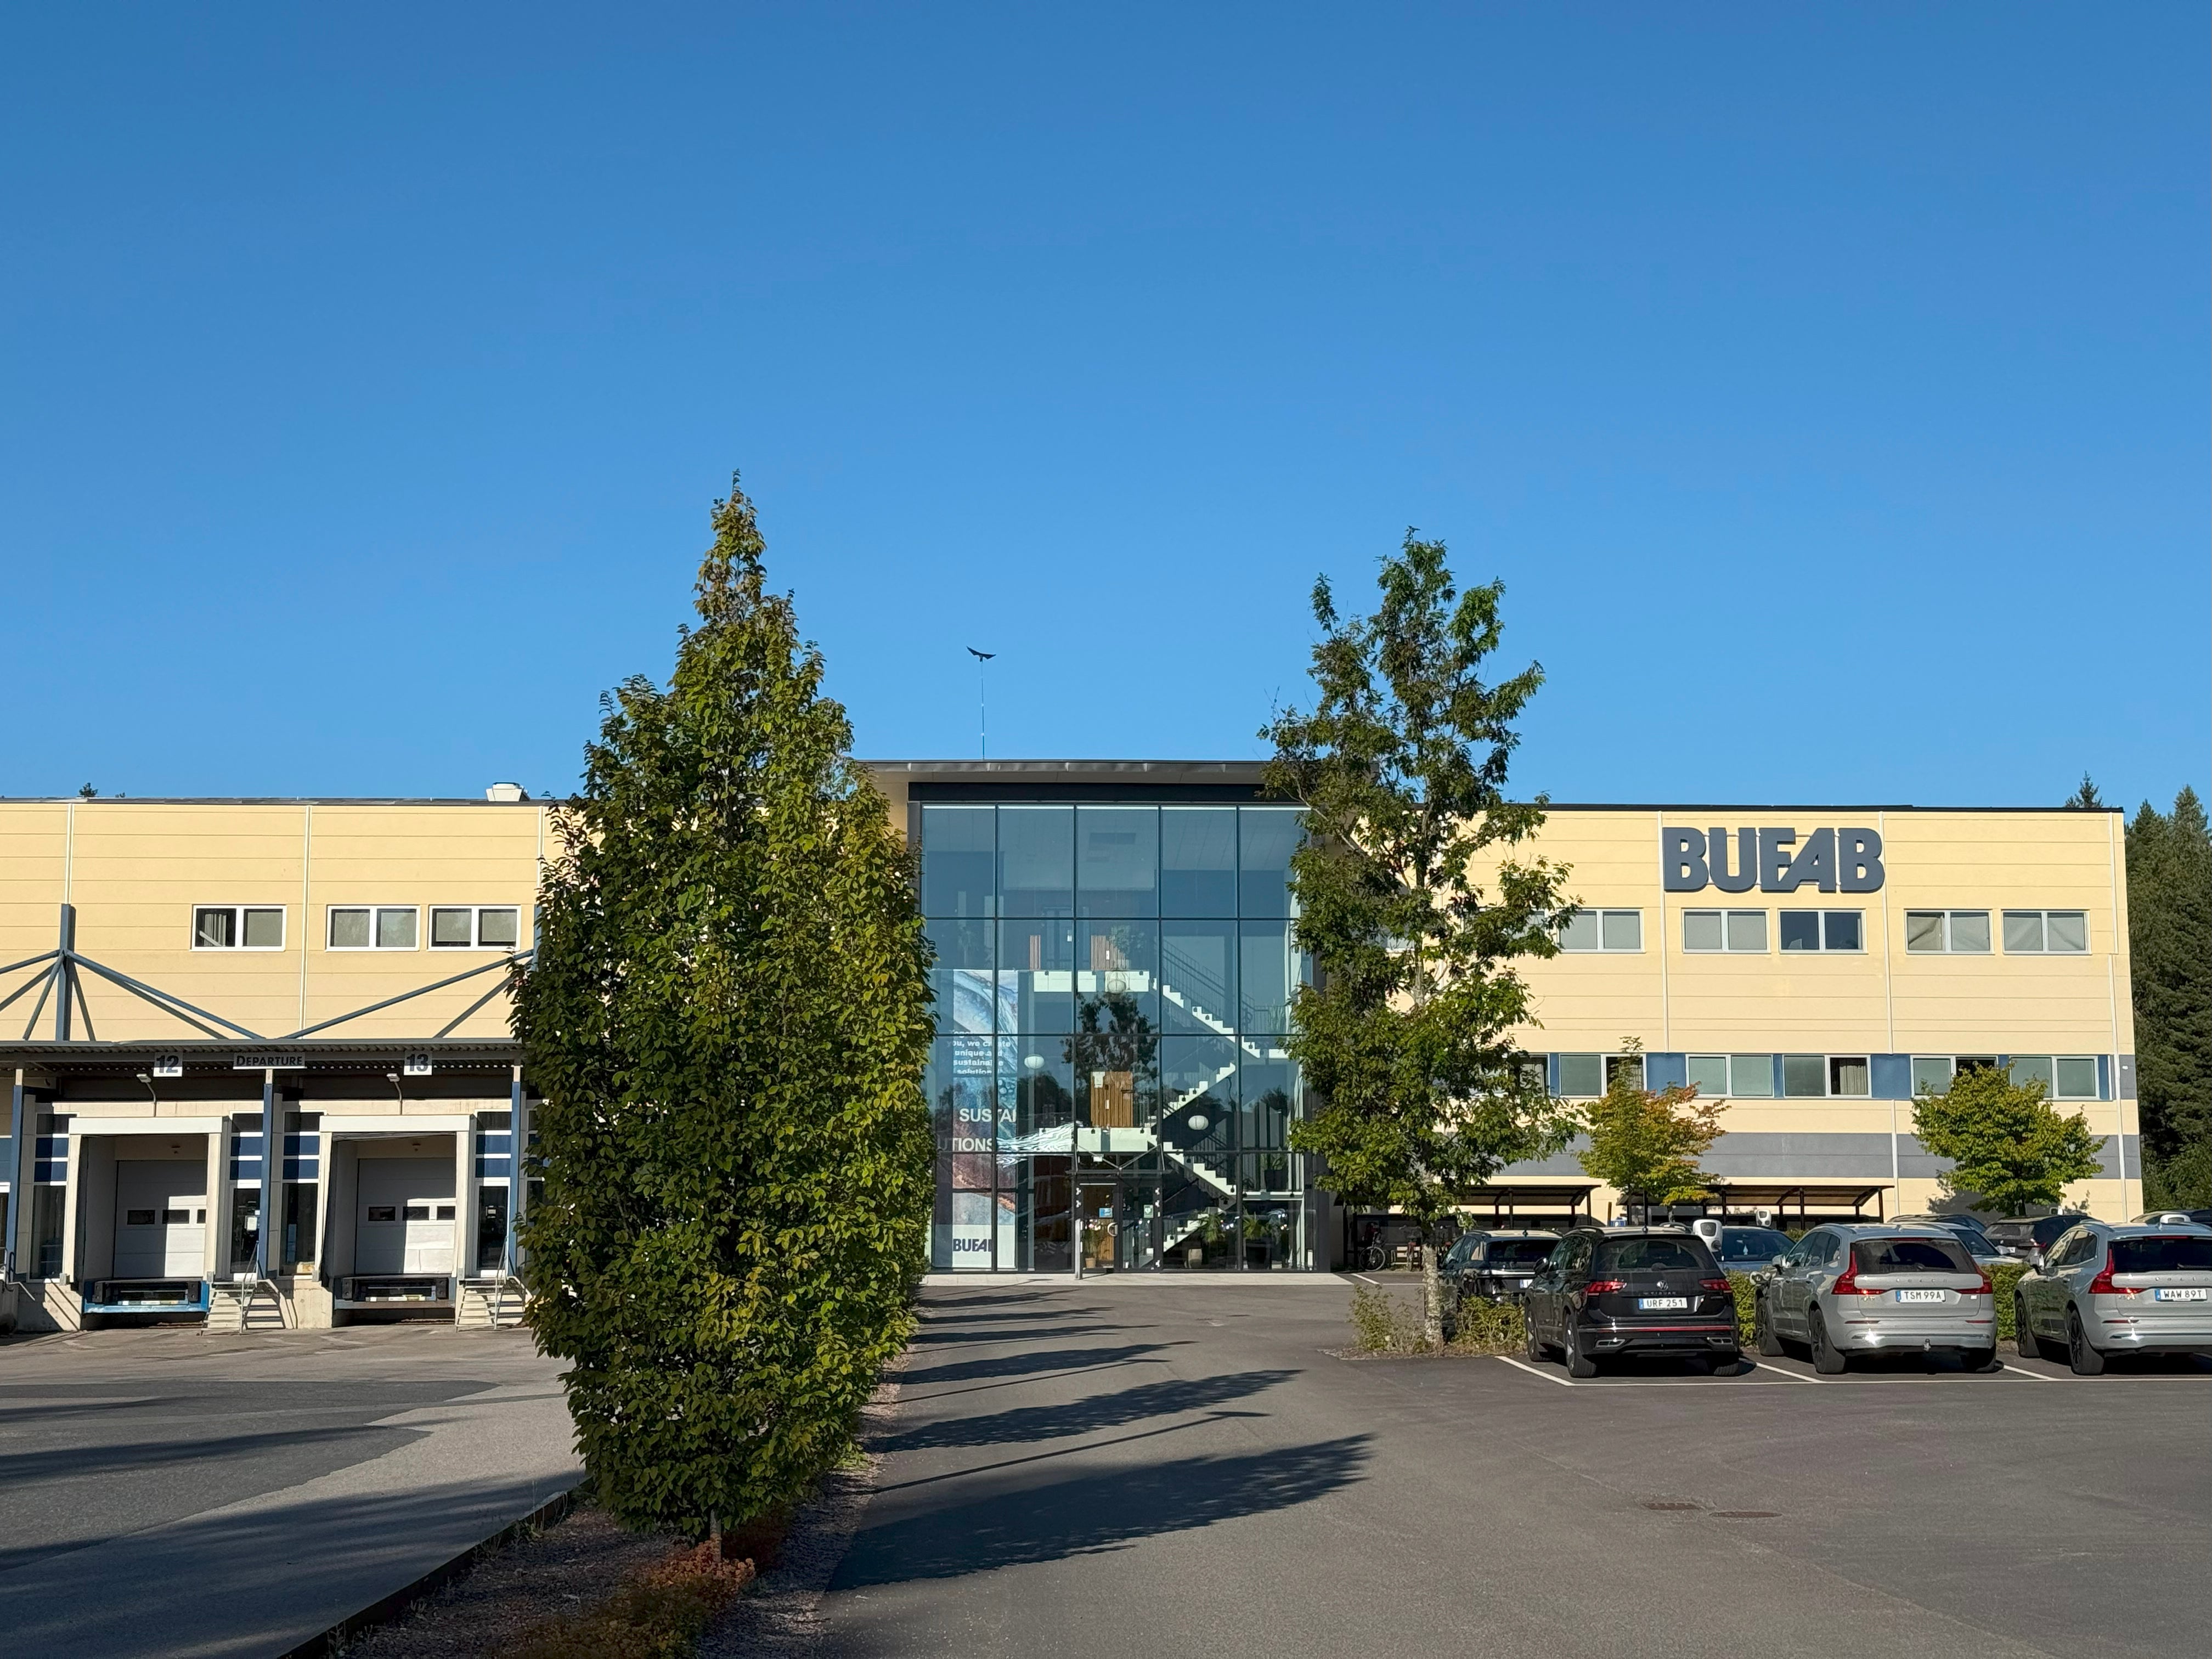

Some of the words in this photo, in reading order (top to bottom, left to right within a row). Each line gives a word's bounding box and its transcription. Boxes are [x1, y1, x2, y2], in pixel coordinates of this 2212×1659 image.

[1662, 827, 1886, 894] BUFAB
[986, 1048, 1002, 1057] ad
[156, 1054, 179, 1074] 12
[236, 1055, 302, 1066] DEPARTURE
[407, 1053, 428, 1072] 13
[1904, 1291, 1921, 1300] TSM
[1923, 1291, 1942, 1300] 99A
[2163, 1290, 2182, 1299] WAW
[2185, 1290, 2202, 1299] 89T
[1646, 1299, 1663, 1308] URF
[1666, 1299, 1683, 1307] 251
